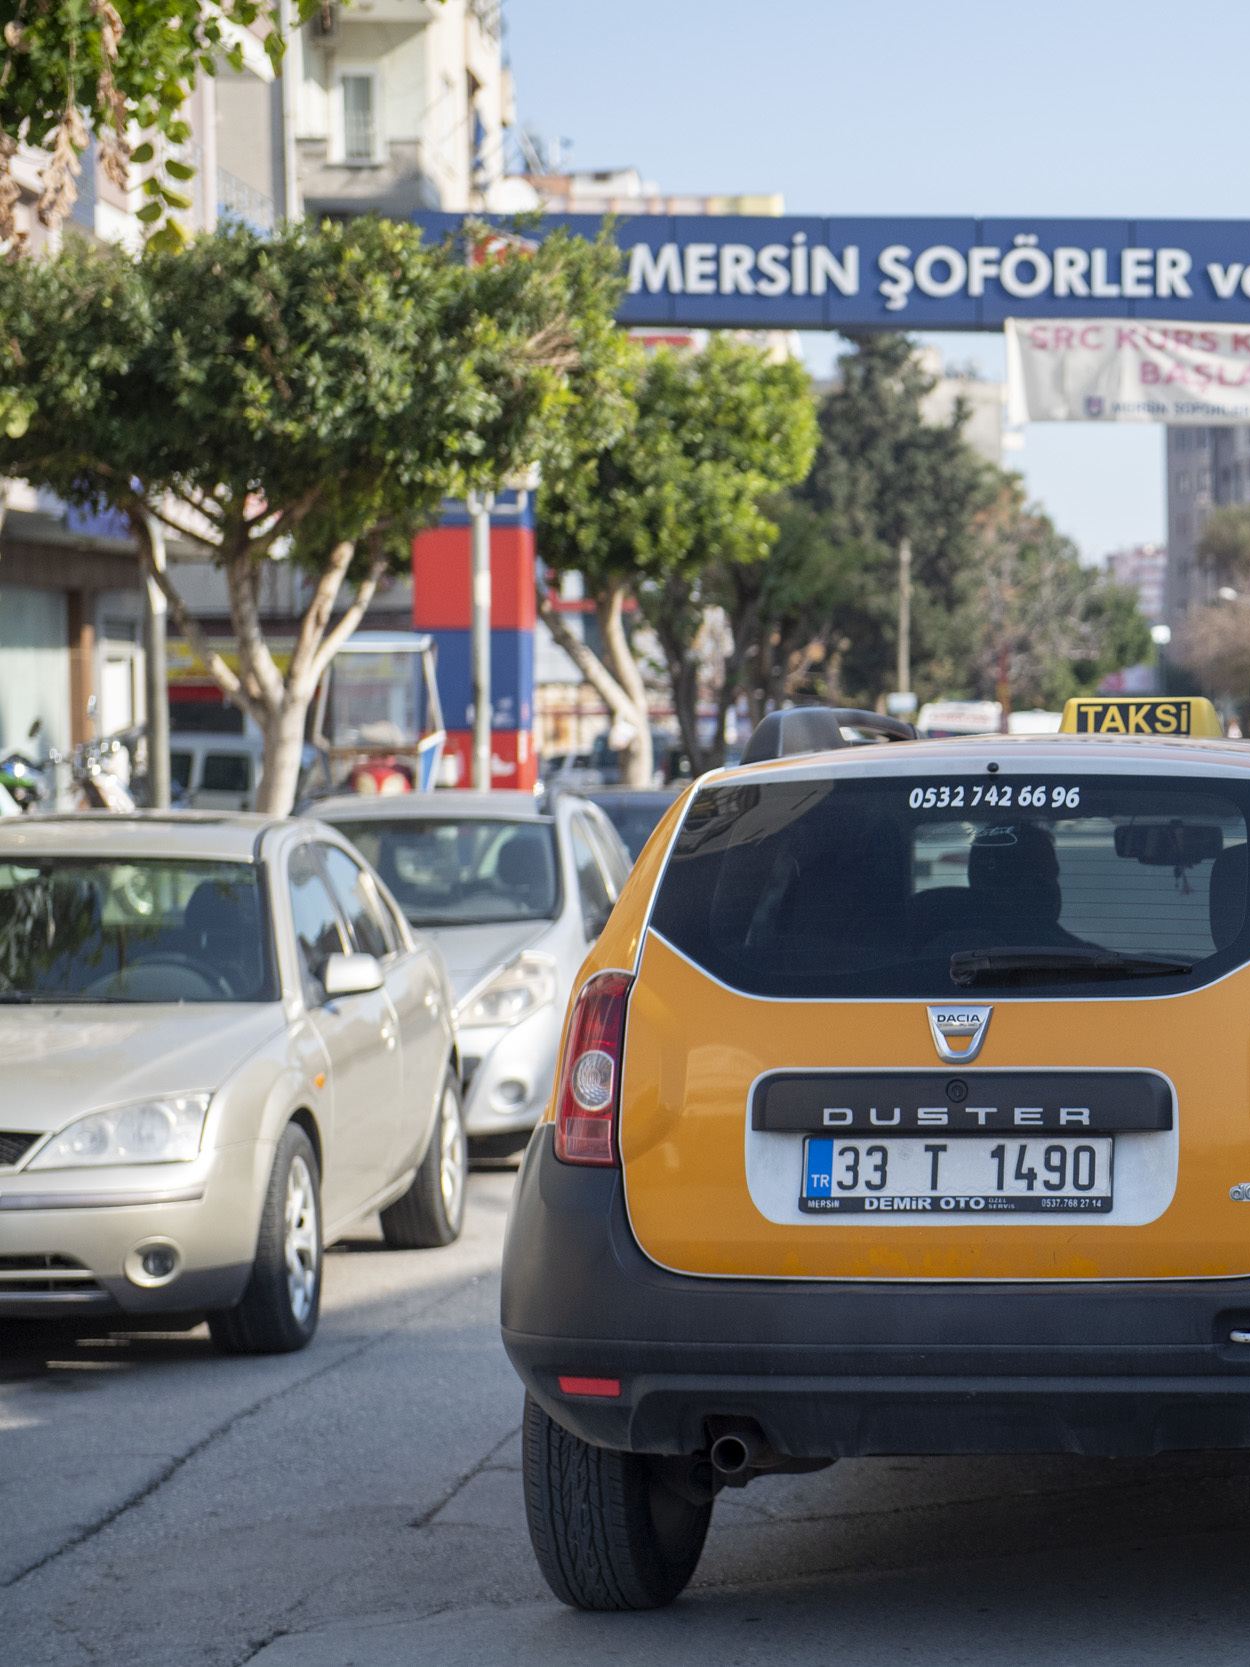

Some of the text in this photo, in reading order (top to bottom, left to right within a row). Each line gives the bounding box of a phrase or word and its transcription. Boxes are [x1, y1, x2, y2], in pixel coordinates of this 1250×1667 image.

[626, 231, 861, 297] MERSİN
[878, 232, 1194, 311] ŞOFÖRLER
[1030, 325, 1105, 350] SRC
[1116, 327, 1218, 353] KURS
[908, 785, 1081, 809] 0532 742 66 96
[937, 1014, 980, 1022] DACIA
[823, 1107, 1090, 1126] DUSTER
[811, 1144, 1096, 1191] TR 33 T 1490
[940, 1197, 985, 1210] OTO
[1080, 1199, 1089, 1208] 27
[1092, 1199, 1102, 1207] 14
